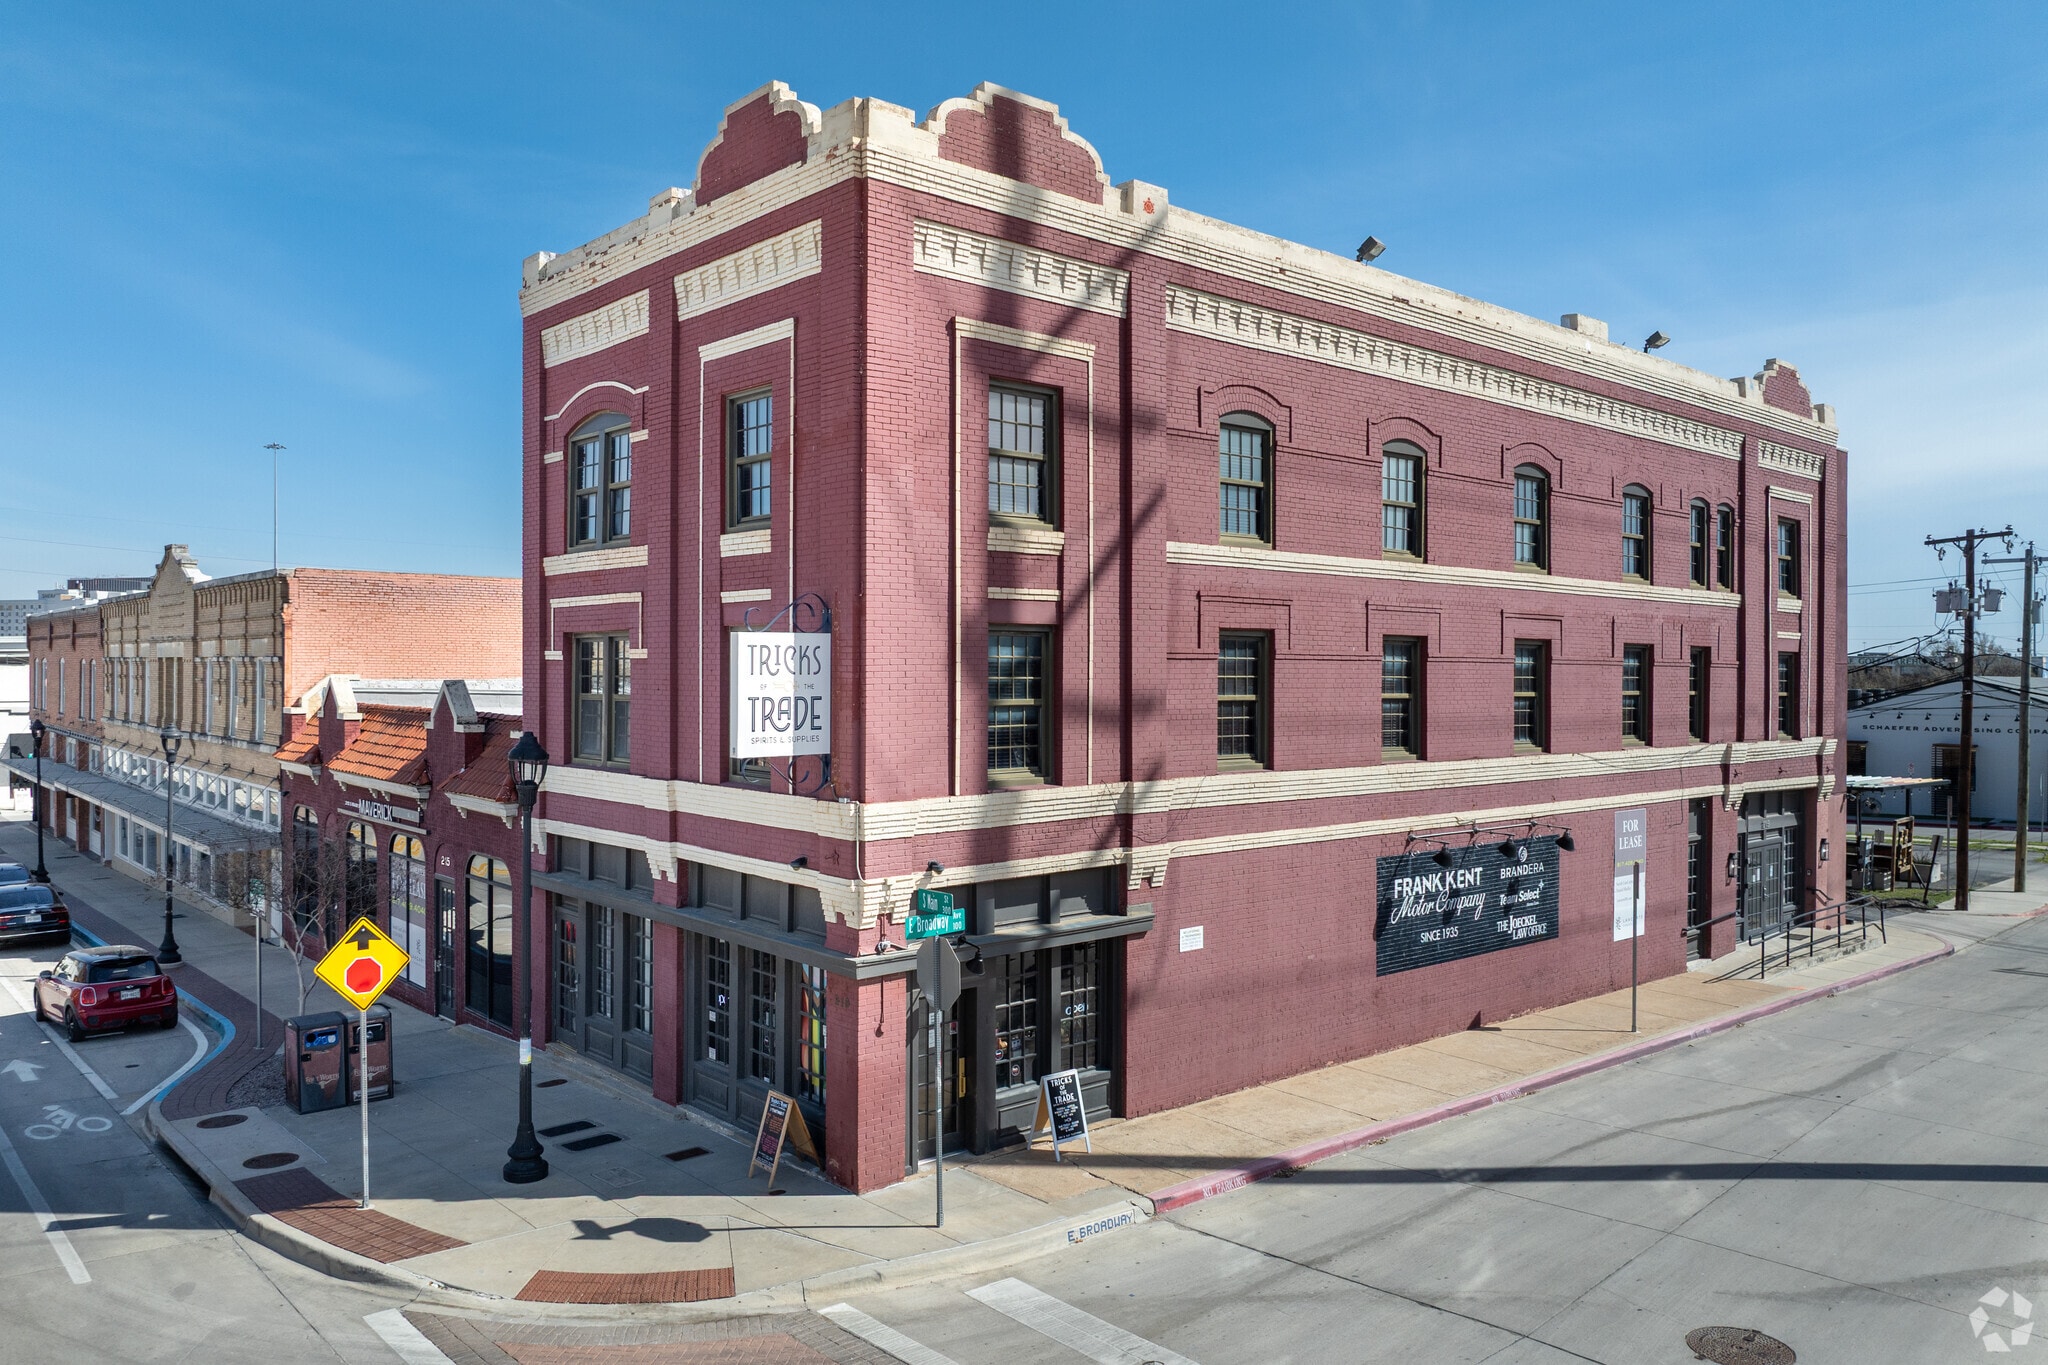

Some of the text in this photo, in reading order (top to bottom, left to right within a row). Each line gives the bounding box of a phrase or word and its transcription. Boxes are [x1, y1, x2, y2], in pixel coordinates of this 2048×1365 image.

[747, 644, 821, 676] TRICKS
[747, 695, 822, 732] TRADE
[1862, 724, 1919, 732] SCHAEFER
[1924, 726, 2001, 734] ADVERSING
[788, 735, 820, 743] SUPPLIES
[358, 798, 393, 822] MAVERICK
[1623, 819, 1639, 833] FOR
[1619, 834, 1643, 850] LEASE
[1500, 862, 1545, 879] BRANDERA
[1394, 866, 1484, 899] FRANK KENT
[922, 892, 949, 911] S Main St
[1500, 894, 1518, 906] Team
[1519, 887, 1540, 902] Select
[1391, 888, 1487, 925] Motor Company
[909, 911, 962, 934] E Broadway Ave
[953, 920, 962, 930] 100
[1496, 914, 1538, 934] THE JOECKEL
[1512, 922, 1548, 940] LAW OFFICE
[1420, 926, 1459, 943] SINCE 1935
[1051, 1076, 1073, 1087] TRICKS
[1054, 1093, 1075, 1104] TRADE
[1203, 1175, 1248, 1198] NO PARKING
[1067, 1214, 1133, 1243] E. BROADWAY
